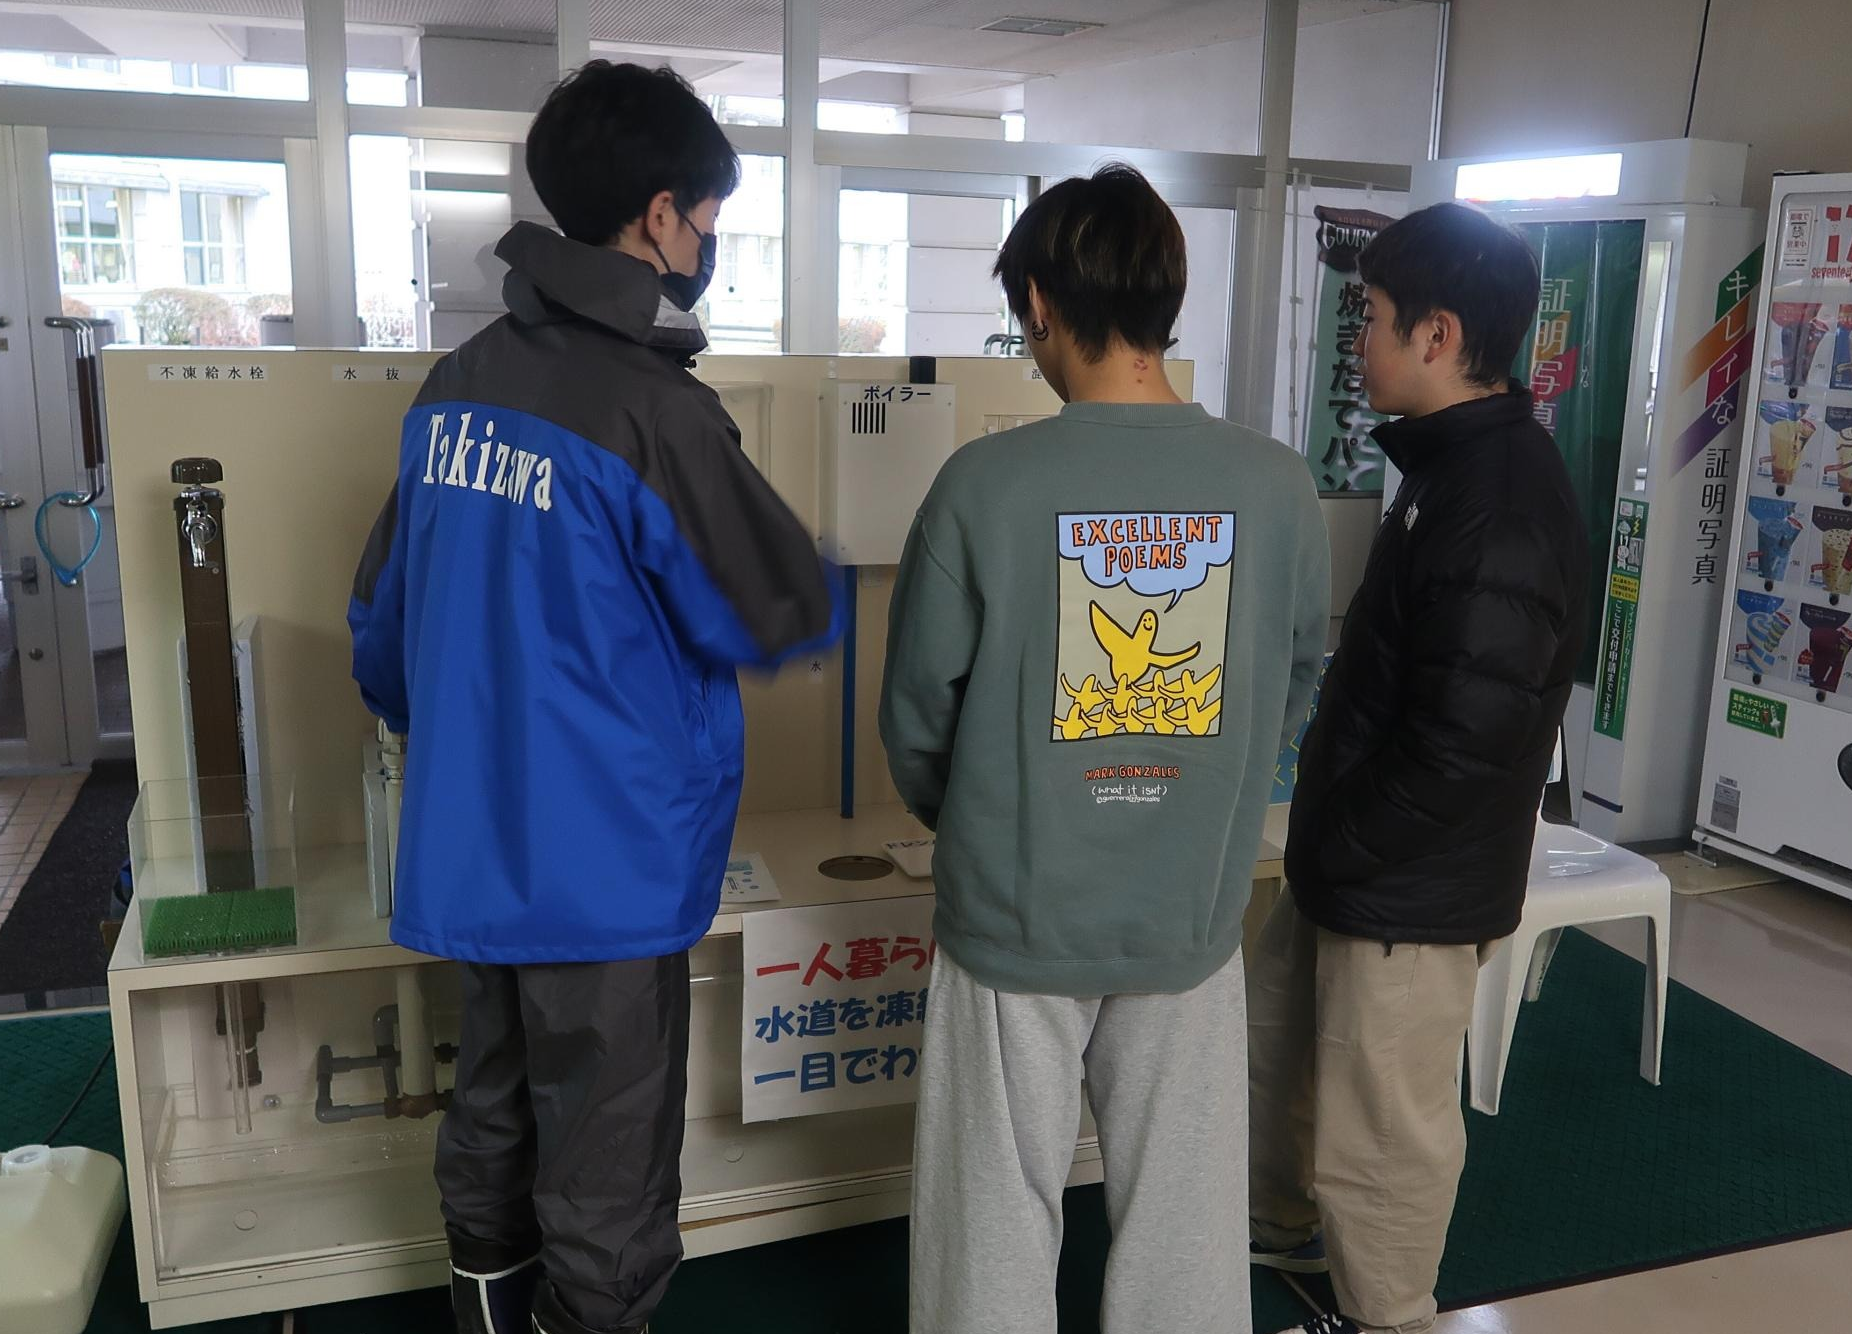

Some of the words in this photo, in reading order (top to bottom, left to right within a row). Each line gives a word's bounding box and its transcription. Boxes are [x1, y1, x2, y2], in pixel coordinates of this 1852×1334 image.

[1826, 203, 1852, 263] 1
[1711, 270, 1748, 426] キレイな
[159, 365, 264, 380] 不凍給水栓
[864, 385, 931, 402] ボイラー
[1071, 515, 1223, 548] EXCELLENT
[1692, 449, 1731, 585] 証明写真
[1104, 541, 1187, 578] POEMS
[1084, 767, 1116, 781] MARK
[1118, 763, 1181, 780] GONZALES
[754, 1044, 921, 1093] 一目でわ
